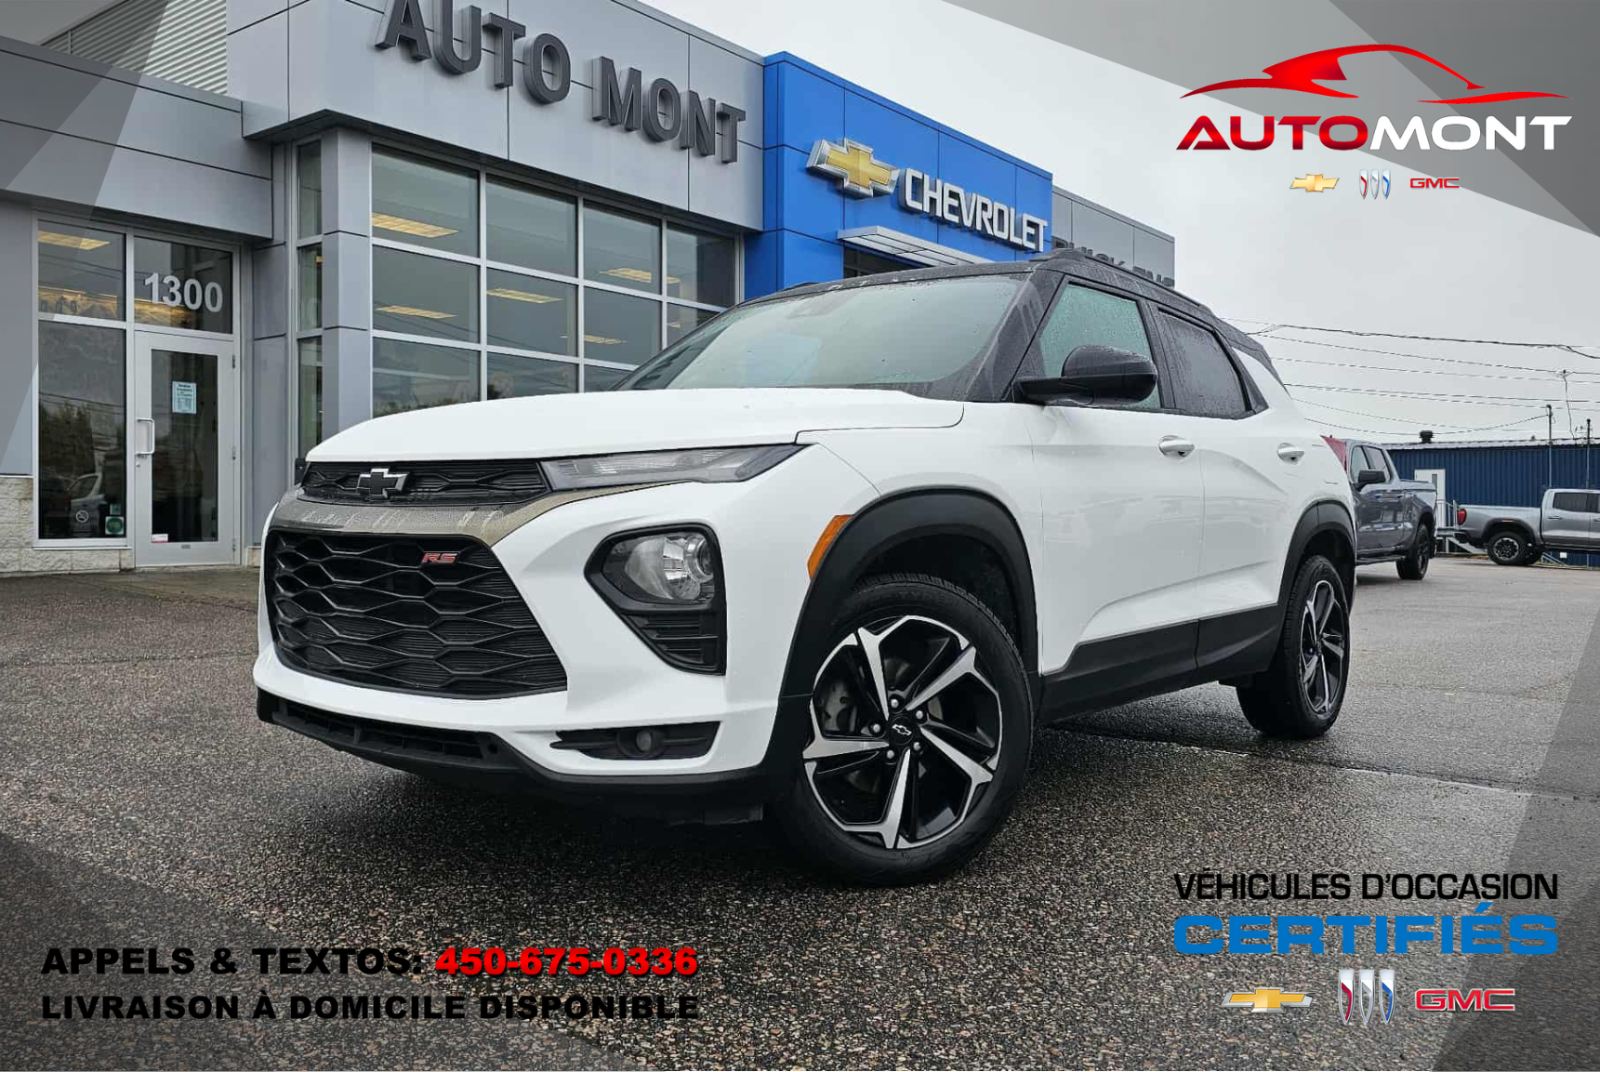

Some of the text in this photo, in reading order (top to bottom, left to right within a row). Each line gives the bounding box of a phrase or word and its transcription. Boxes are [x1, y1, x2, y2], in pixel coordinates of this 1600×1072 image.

[375, 0, 747, 164] AUTO MONT
[899, 167, 1048, 252] CHEVROLET
[144, 272, 223, 313] 1300
[421, 552, 458, 564] RS
